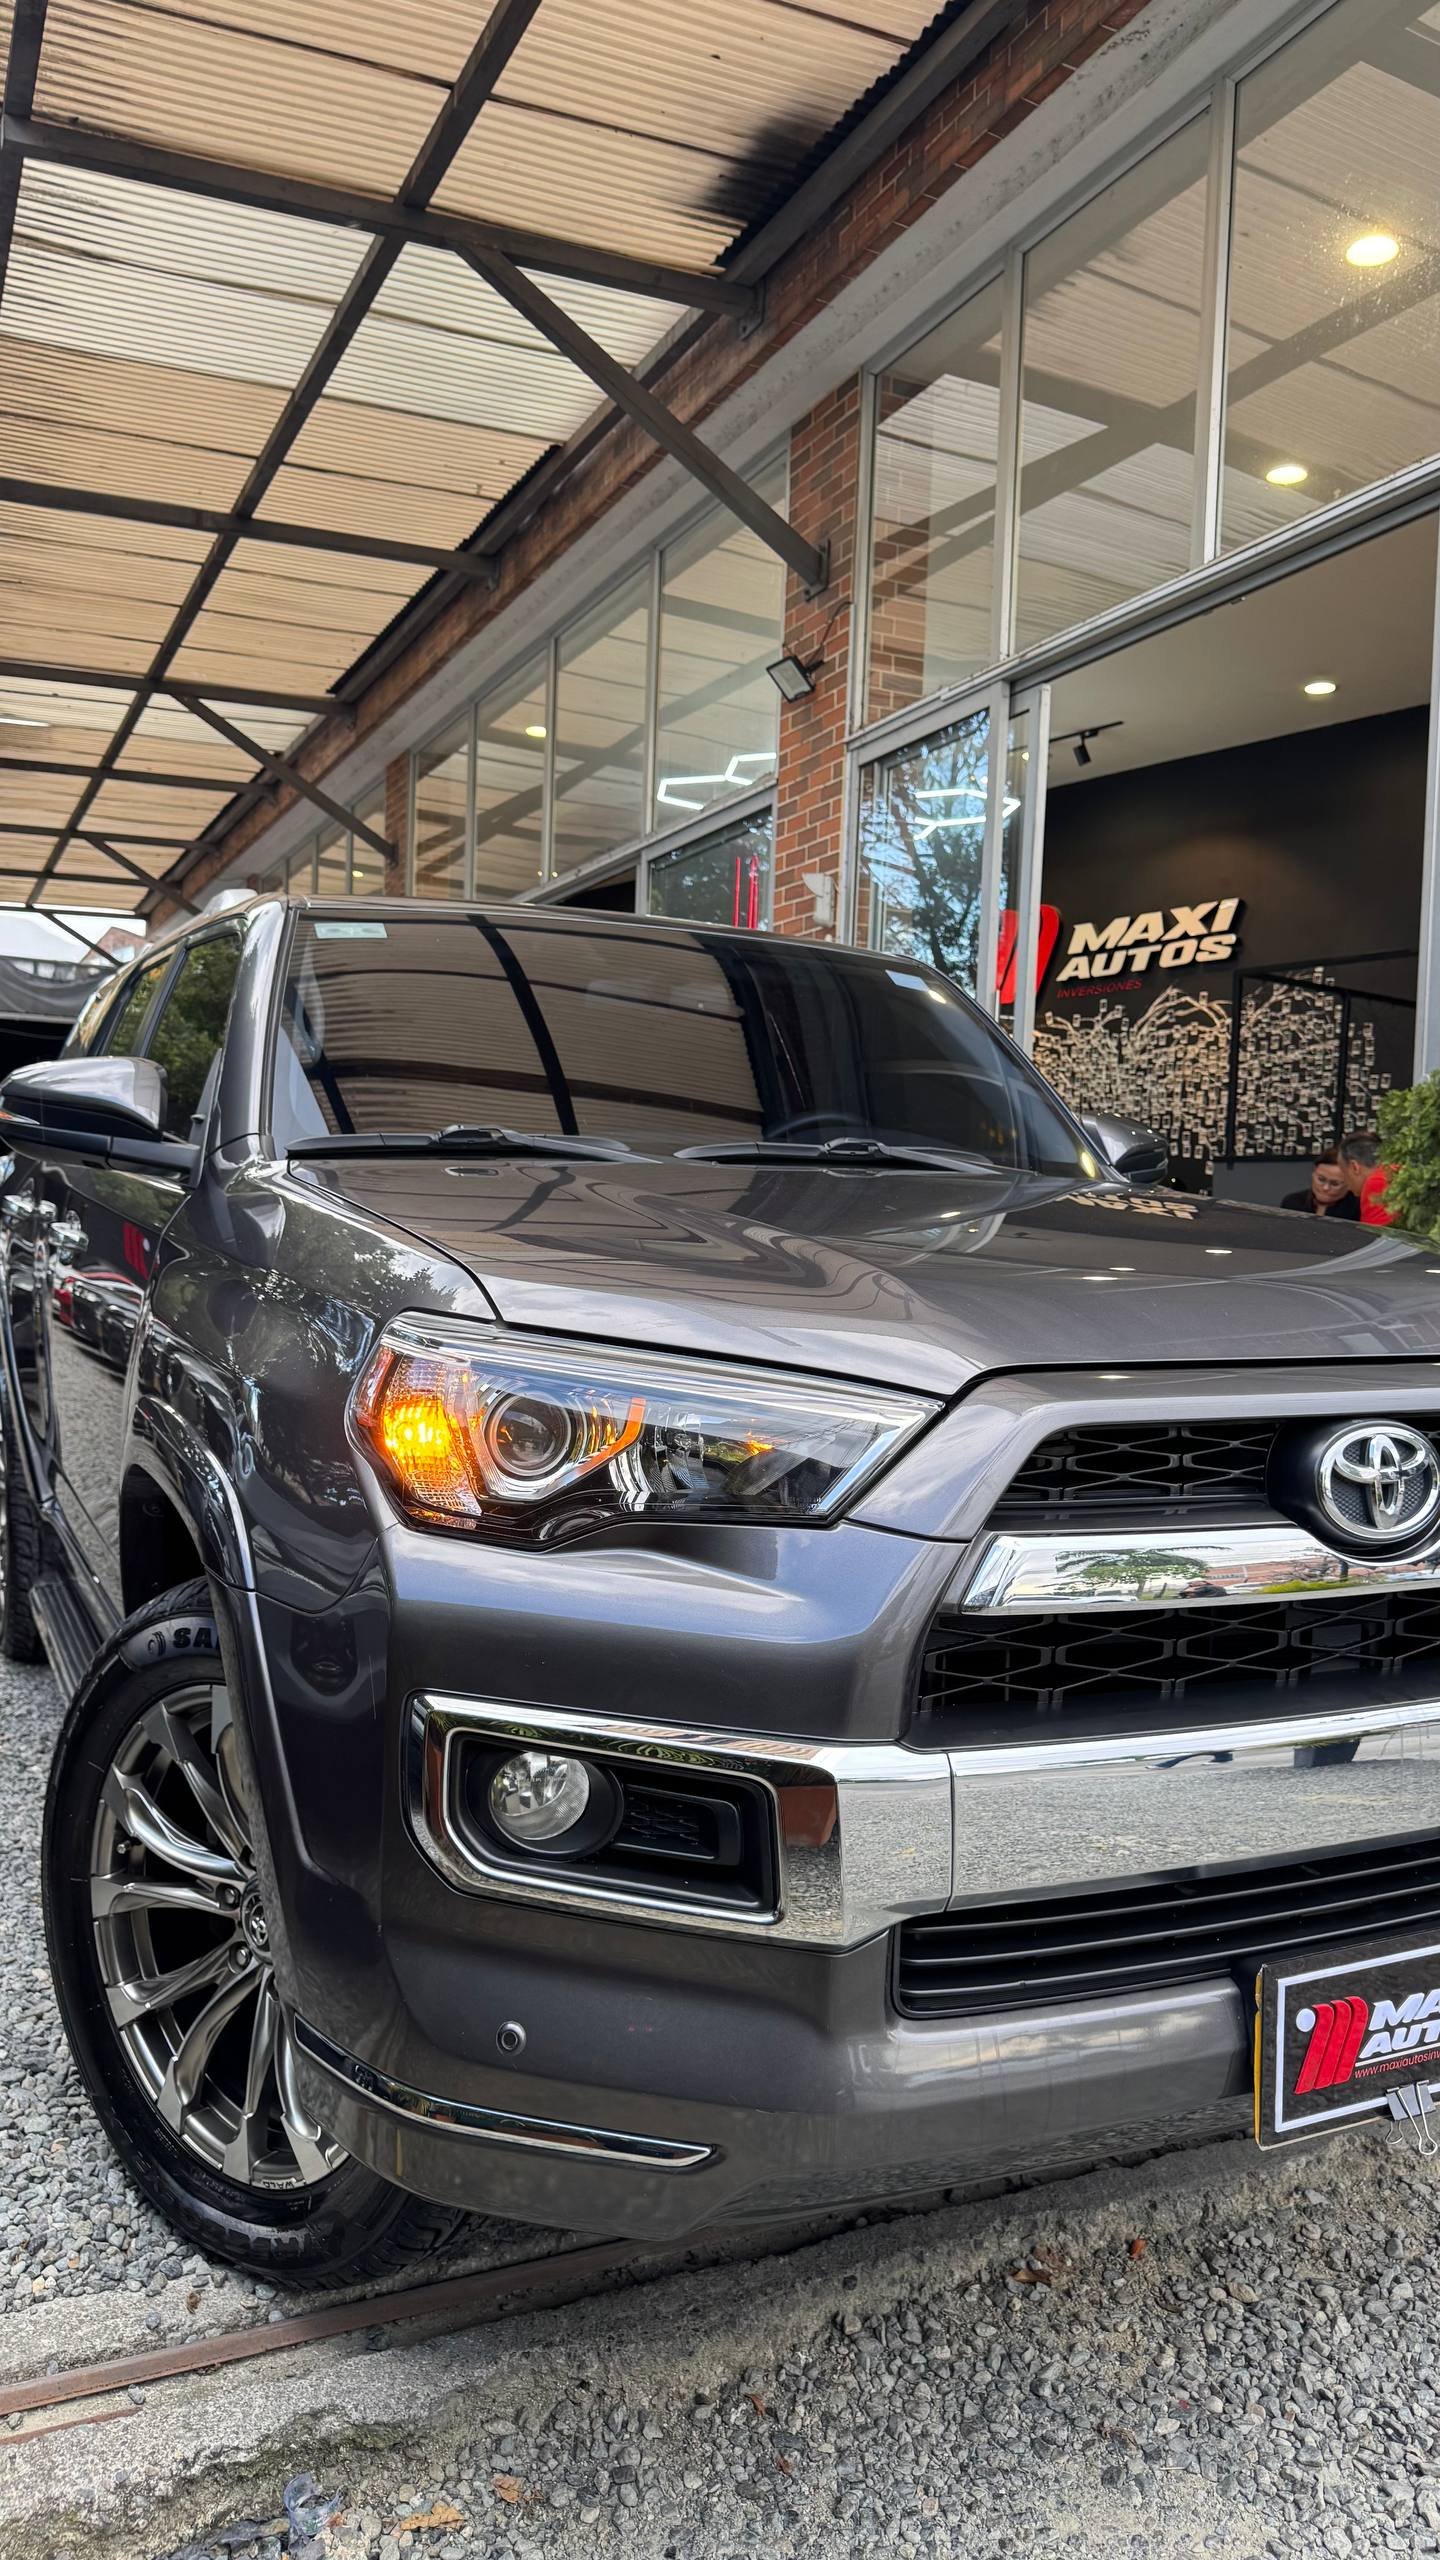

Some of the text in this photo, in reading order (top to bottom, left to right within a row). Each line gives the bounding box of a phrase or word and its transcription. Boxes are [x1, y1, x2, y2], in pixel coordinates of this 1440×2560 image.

[1067, 898, 1239, 955] MAXI
[1056, 933, 1237, 982] AUTOS
[1056, 979, 1143, 999] INVERSIONES
[172, 1627, 220, 1649] SA
